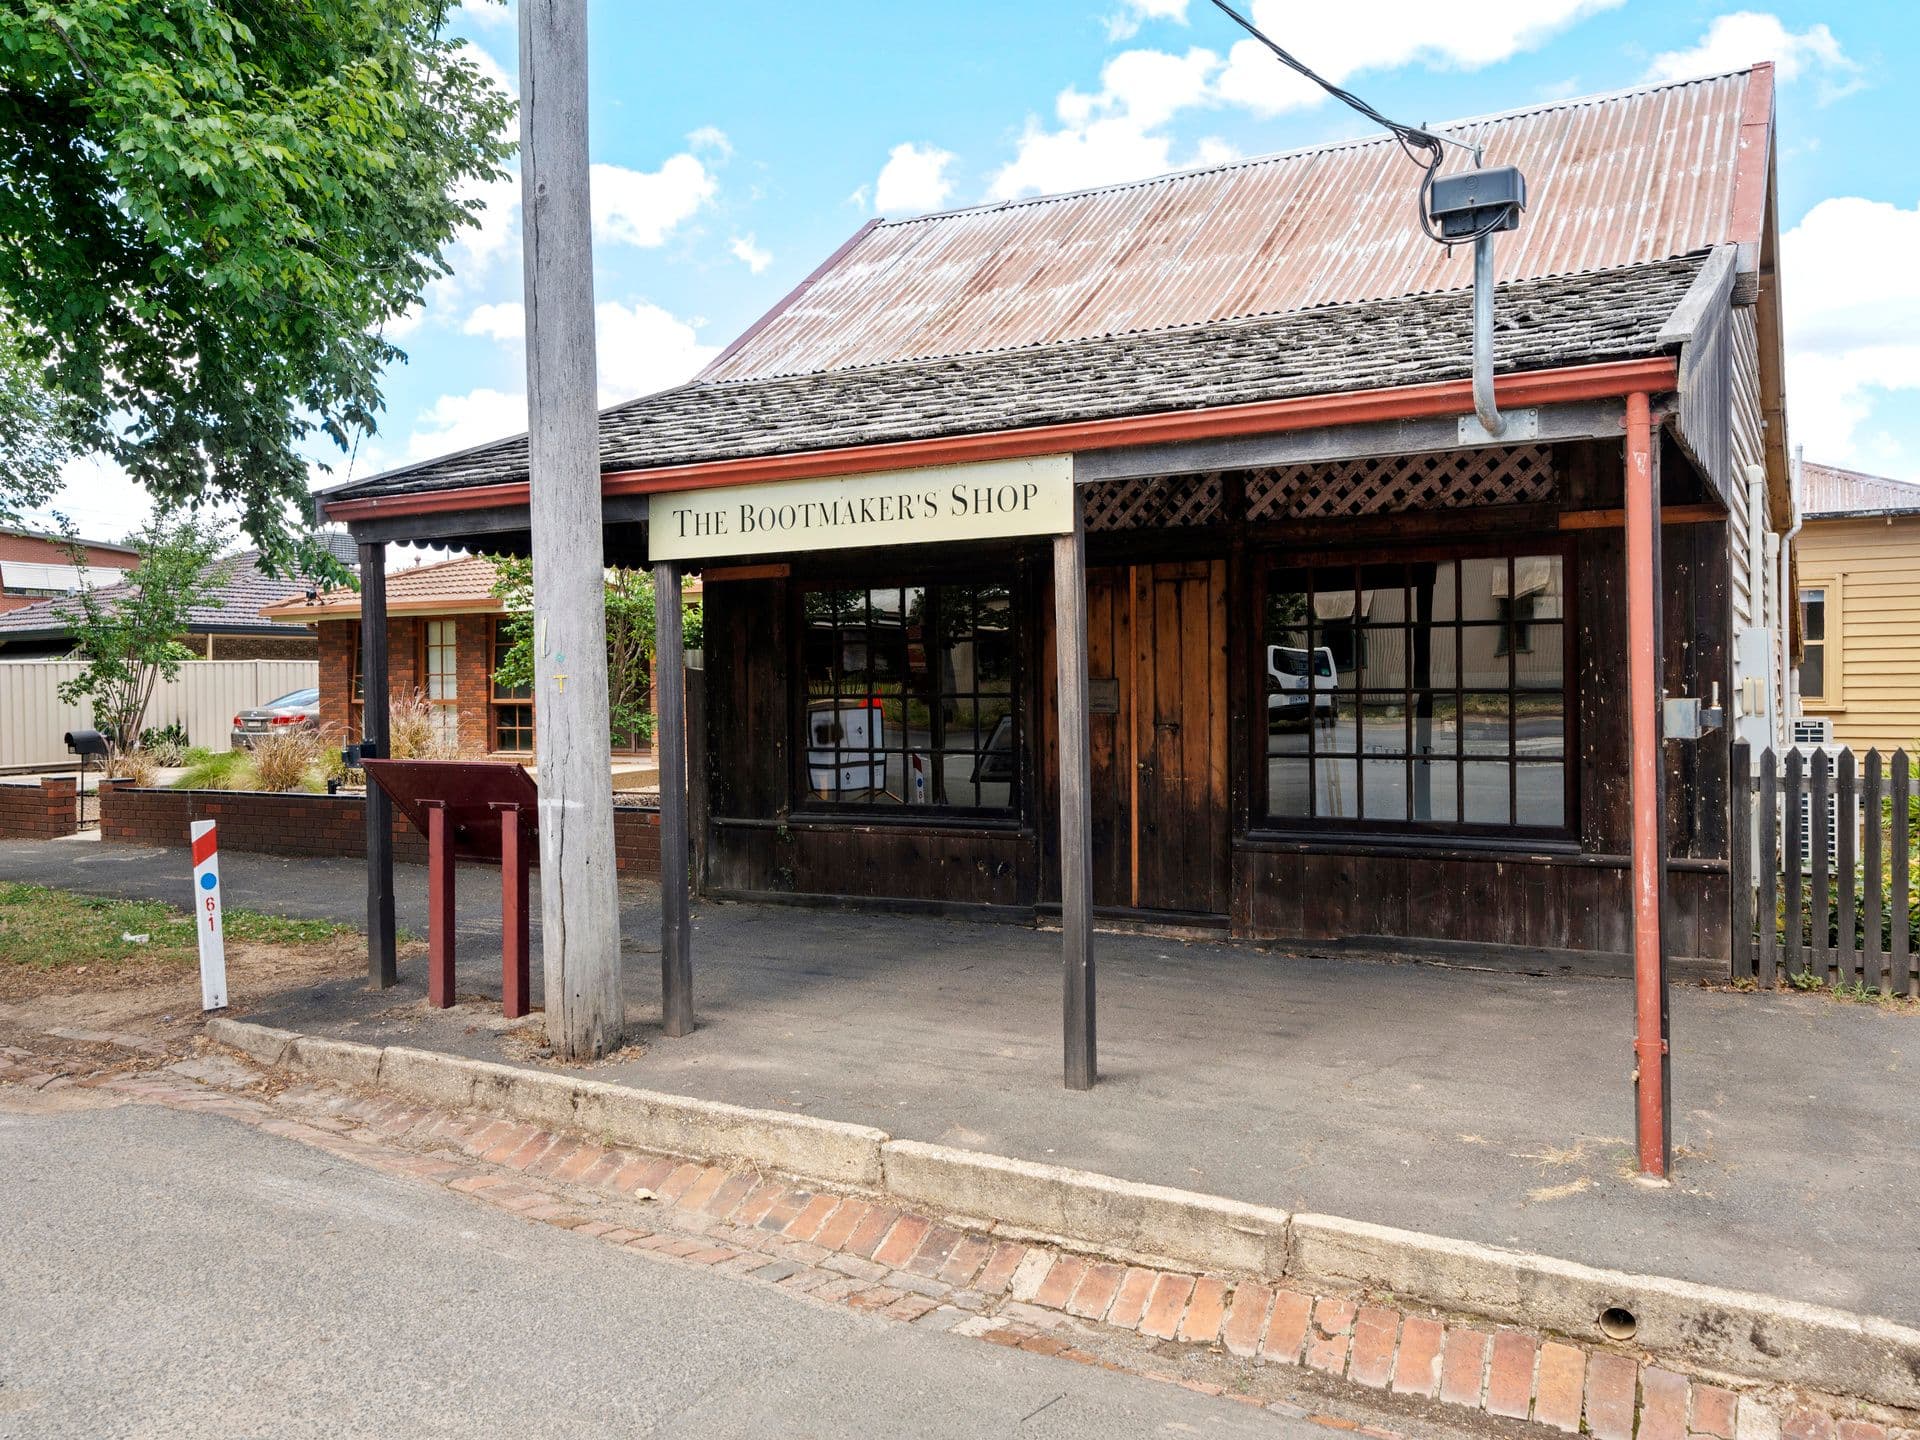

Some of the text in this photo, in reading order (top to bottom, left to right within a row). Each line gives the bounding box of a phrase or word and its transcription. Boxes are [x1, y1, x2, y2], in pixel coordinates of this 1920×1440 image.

[672, 483, 1038, 538] THE BOOTMAKER'S SHOP
